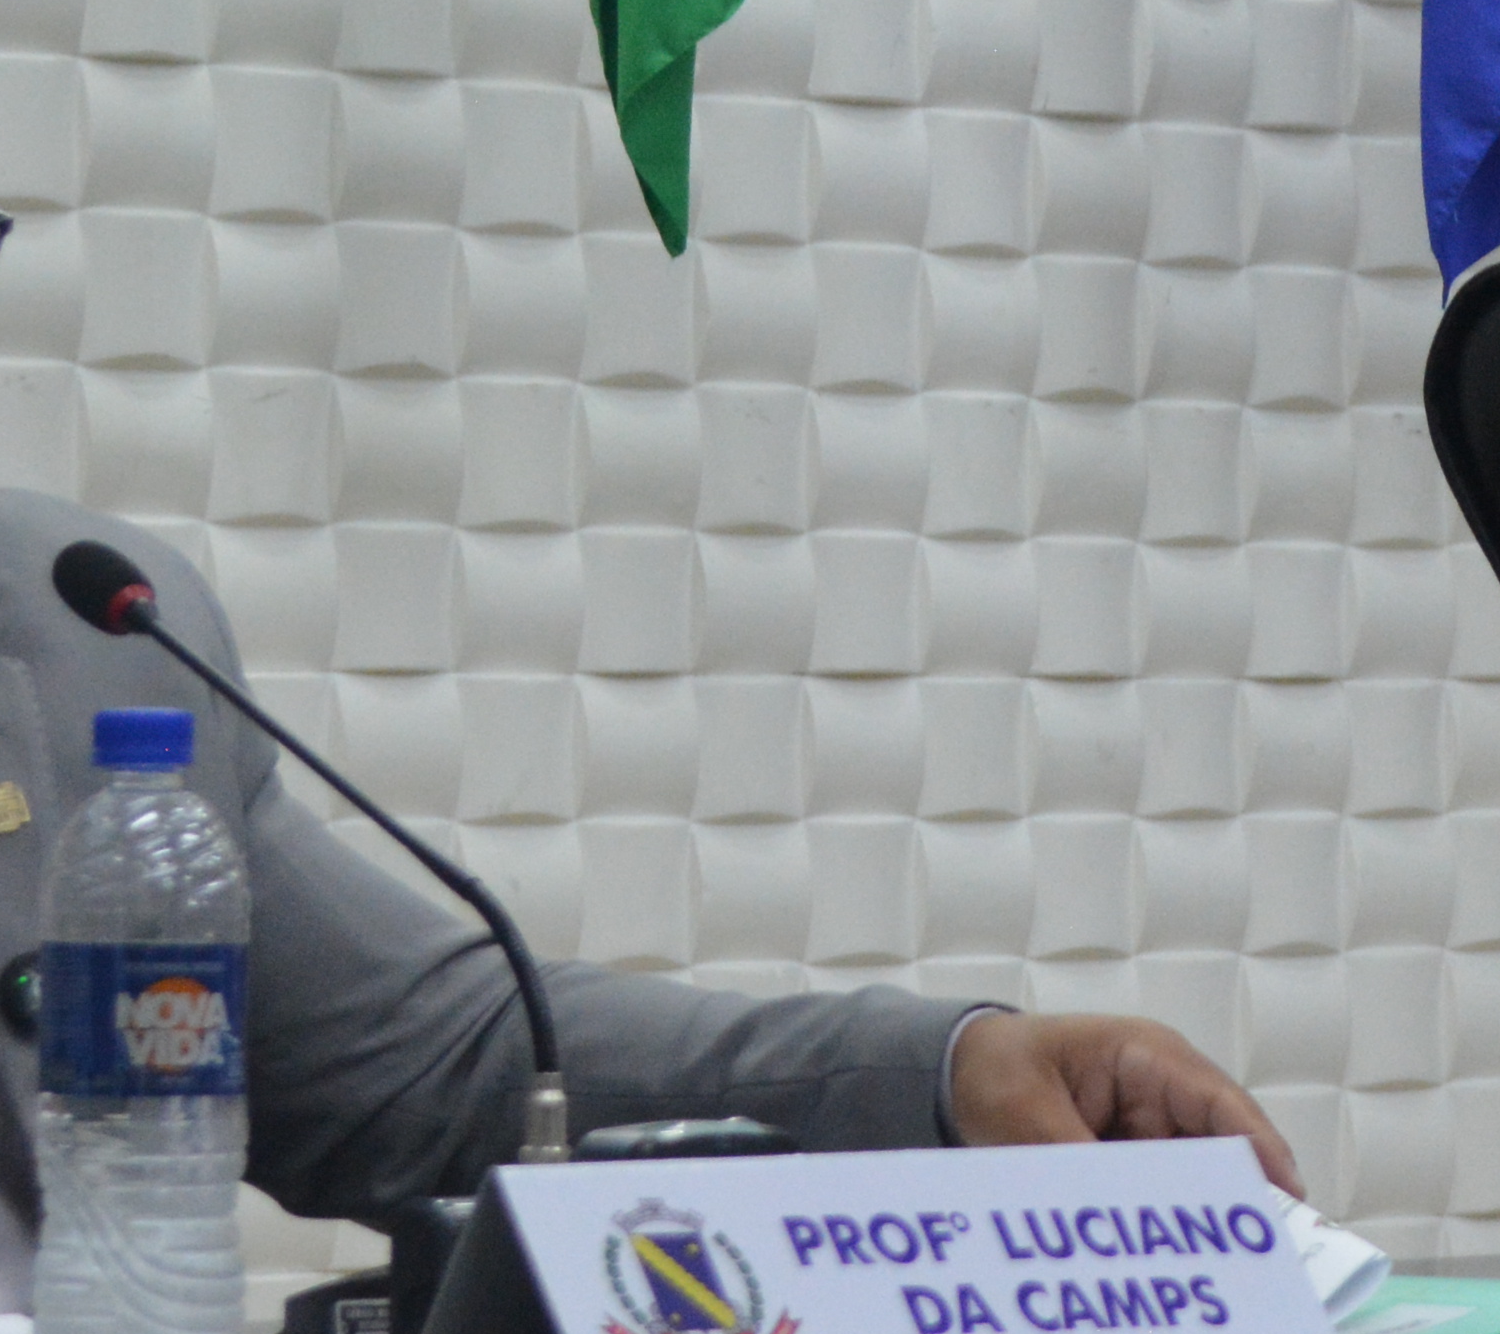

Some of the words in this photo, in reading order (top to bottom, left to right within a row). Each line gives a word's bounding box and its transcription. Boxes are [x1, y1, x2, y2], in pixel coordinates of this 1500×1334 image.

[115, 991, 231, 1030] NOVA
[122, 1027, 225, 1066] VIDA
[990, 1202, 1277, 1260] LUCIANO
[1016, 1274, 1231, 1332] CAMPS
